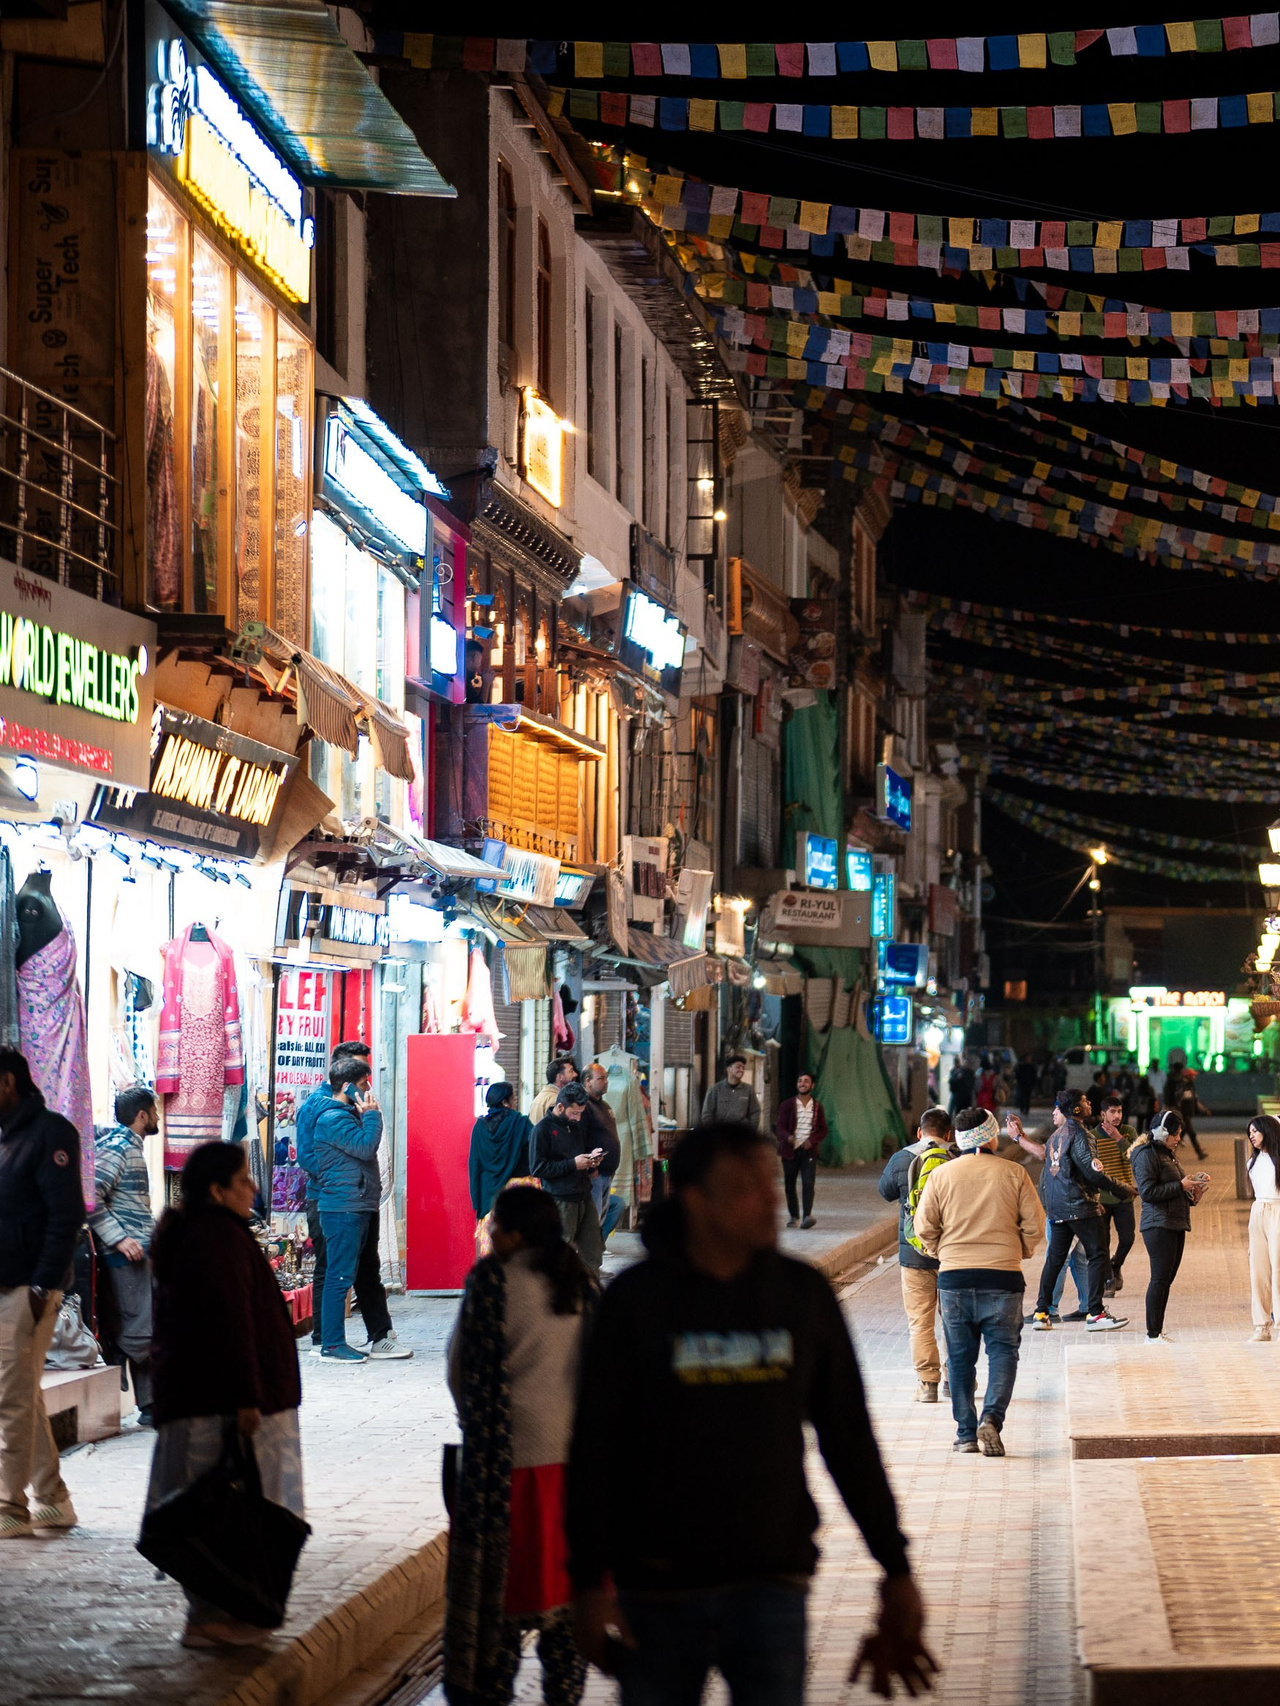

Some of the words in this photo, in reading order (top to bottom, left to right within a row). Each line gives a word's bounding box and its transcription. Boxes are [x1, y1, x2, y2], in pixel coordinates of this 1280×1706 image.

[54, 234, 79, 288] Tech
[27, 257, 58, 324] Super
[0, 610, 55, 697] WORLD
[57, 632, 139, 724] JEWELLERS
[782, 907, 836, 920] RESTAURANT
[801, 899, 837, 911] RI-YUL
[277, 1055, 291, 1067] OF
[292, 1056, 304, 1067] DRY
